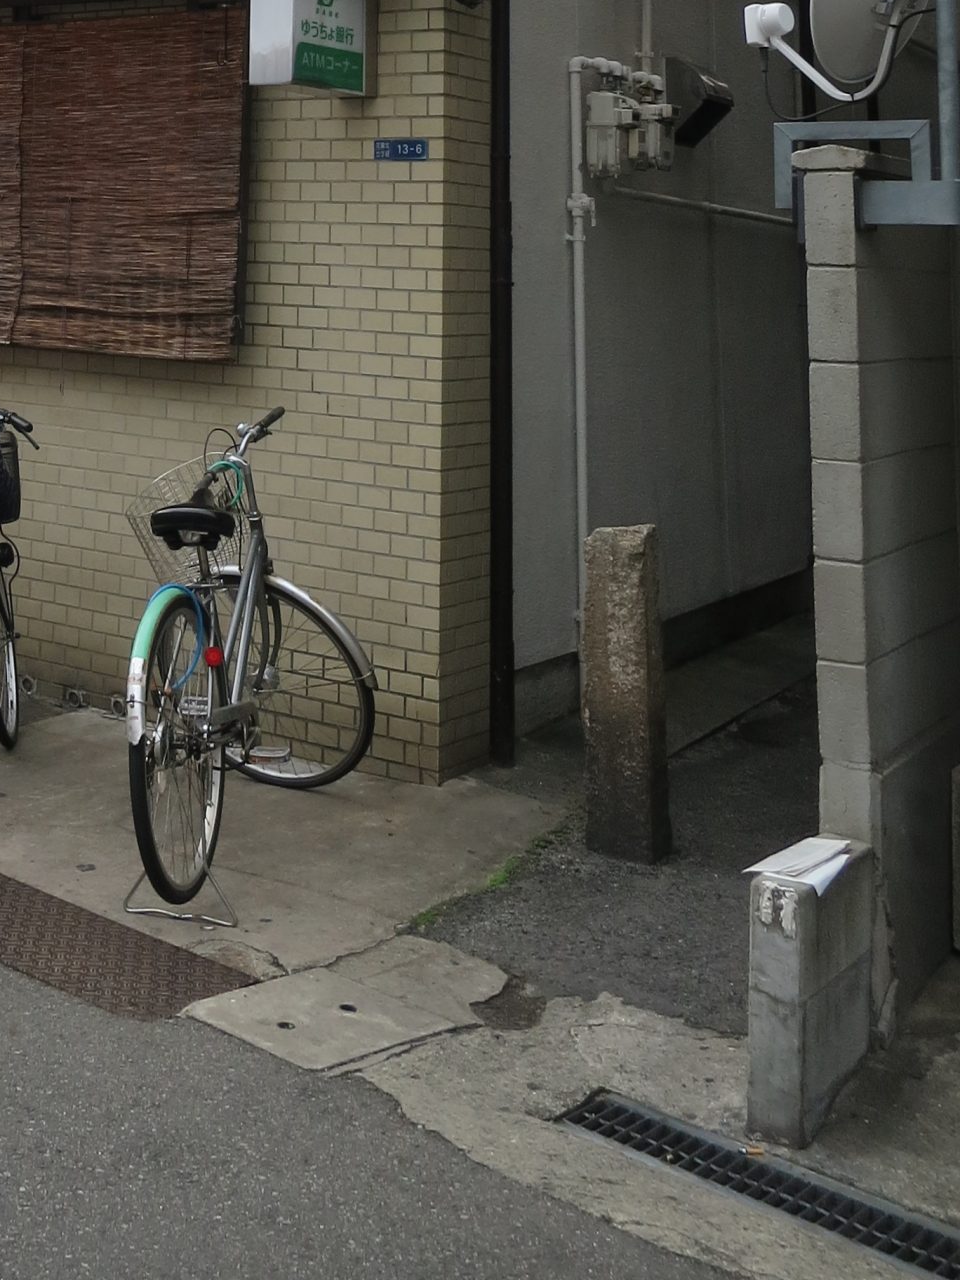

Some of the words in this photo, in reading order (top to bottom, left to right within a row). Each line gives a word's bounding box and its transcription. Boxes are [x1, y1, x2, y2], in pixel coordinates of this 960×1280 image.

[300, 19, 355, 46] ゆうちょ銀行
[302, 51, 359, 73] ATMコーナー
[398, 143, 423, 155] 13-6
